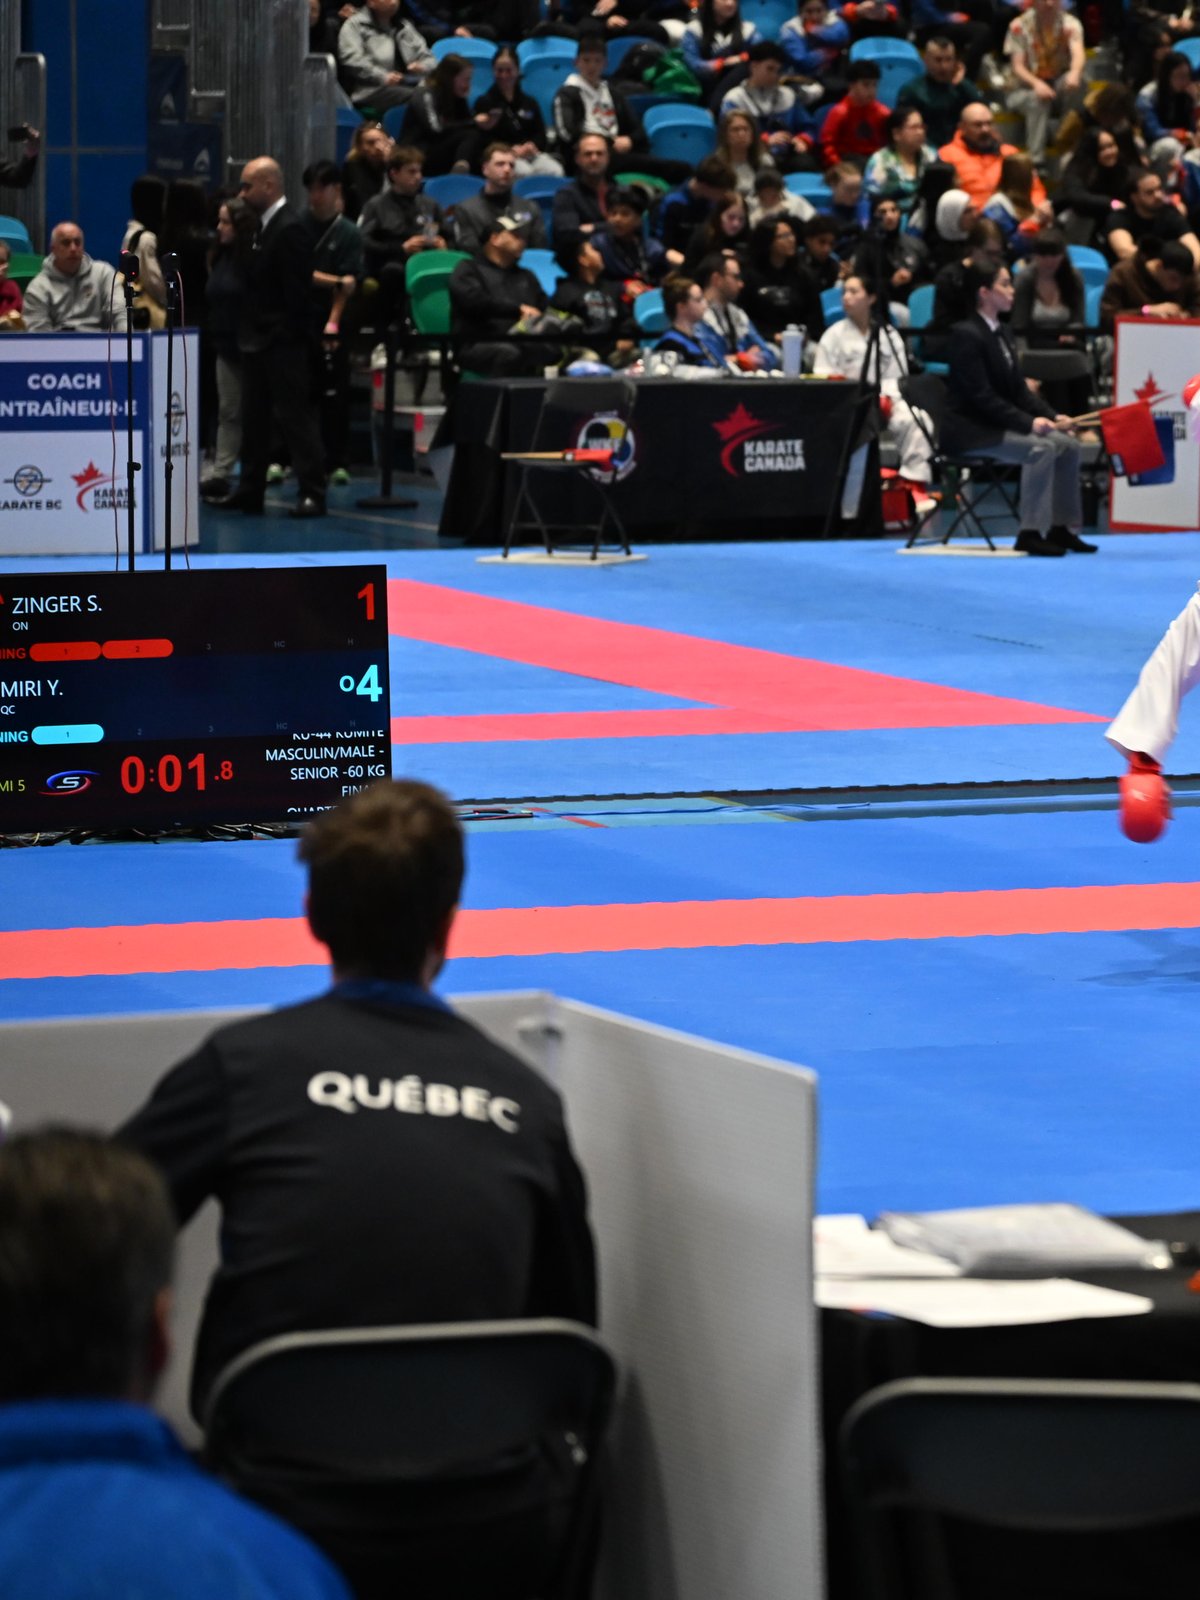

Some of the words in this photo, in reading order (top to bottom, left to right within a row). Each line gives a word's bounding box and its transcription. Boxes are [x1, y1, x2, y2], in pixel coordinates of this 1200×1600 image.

[27, 373, 102, 390] COACH
[744, 439, 803, 456] KARATE
[744, 455, 806, 472] CANADA
[94, 487, 136, 498] KARAT
[0, 500, 41, 511] ARATE
[46, 500, 62, 510] BC
[12, 596, 82, 614] ZINGER
[87, 595, 102, 612] S.
[357, 582, 375, 620] 1
[12, 621, 29, 631] ON
[0, 647, 27, 660] ING
[47, 679, 63, 696] Y.
[1, 705, 16, 715] QC
[265, 745, 375, 761] MASCULIN/MALE
[290, 766, 339, 780] SENIOR
[342, 765, 364, 778] -60
[367, 764, 385, 776] KG
[18, 779, 26, 792] 5
[306, 1070, 522, 1134] QUÉBEC
